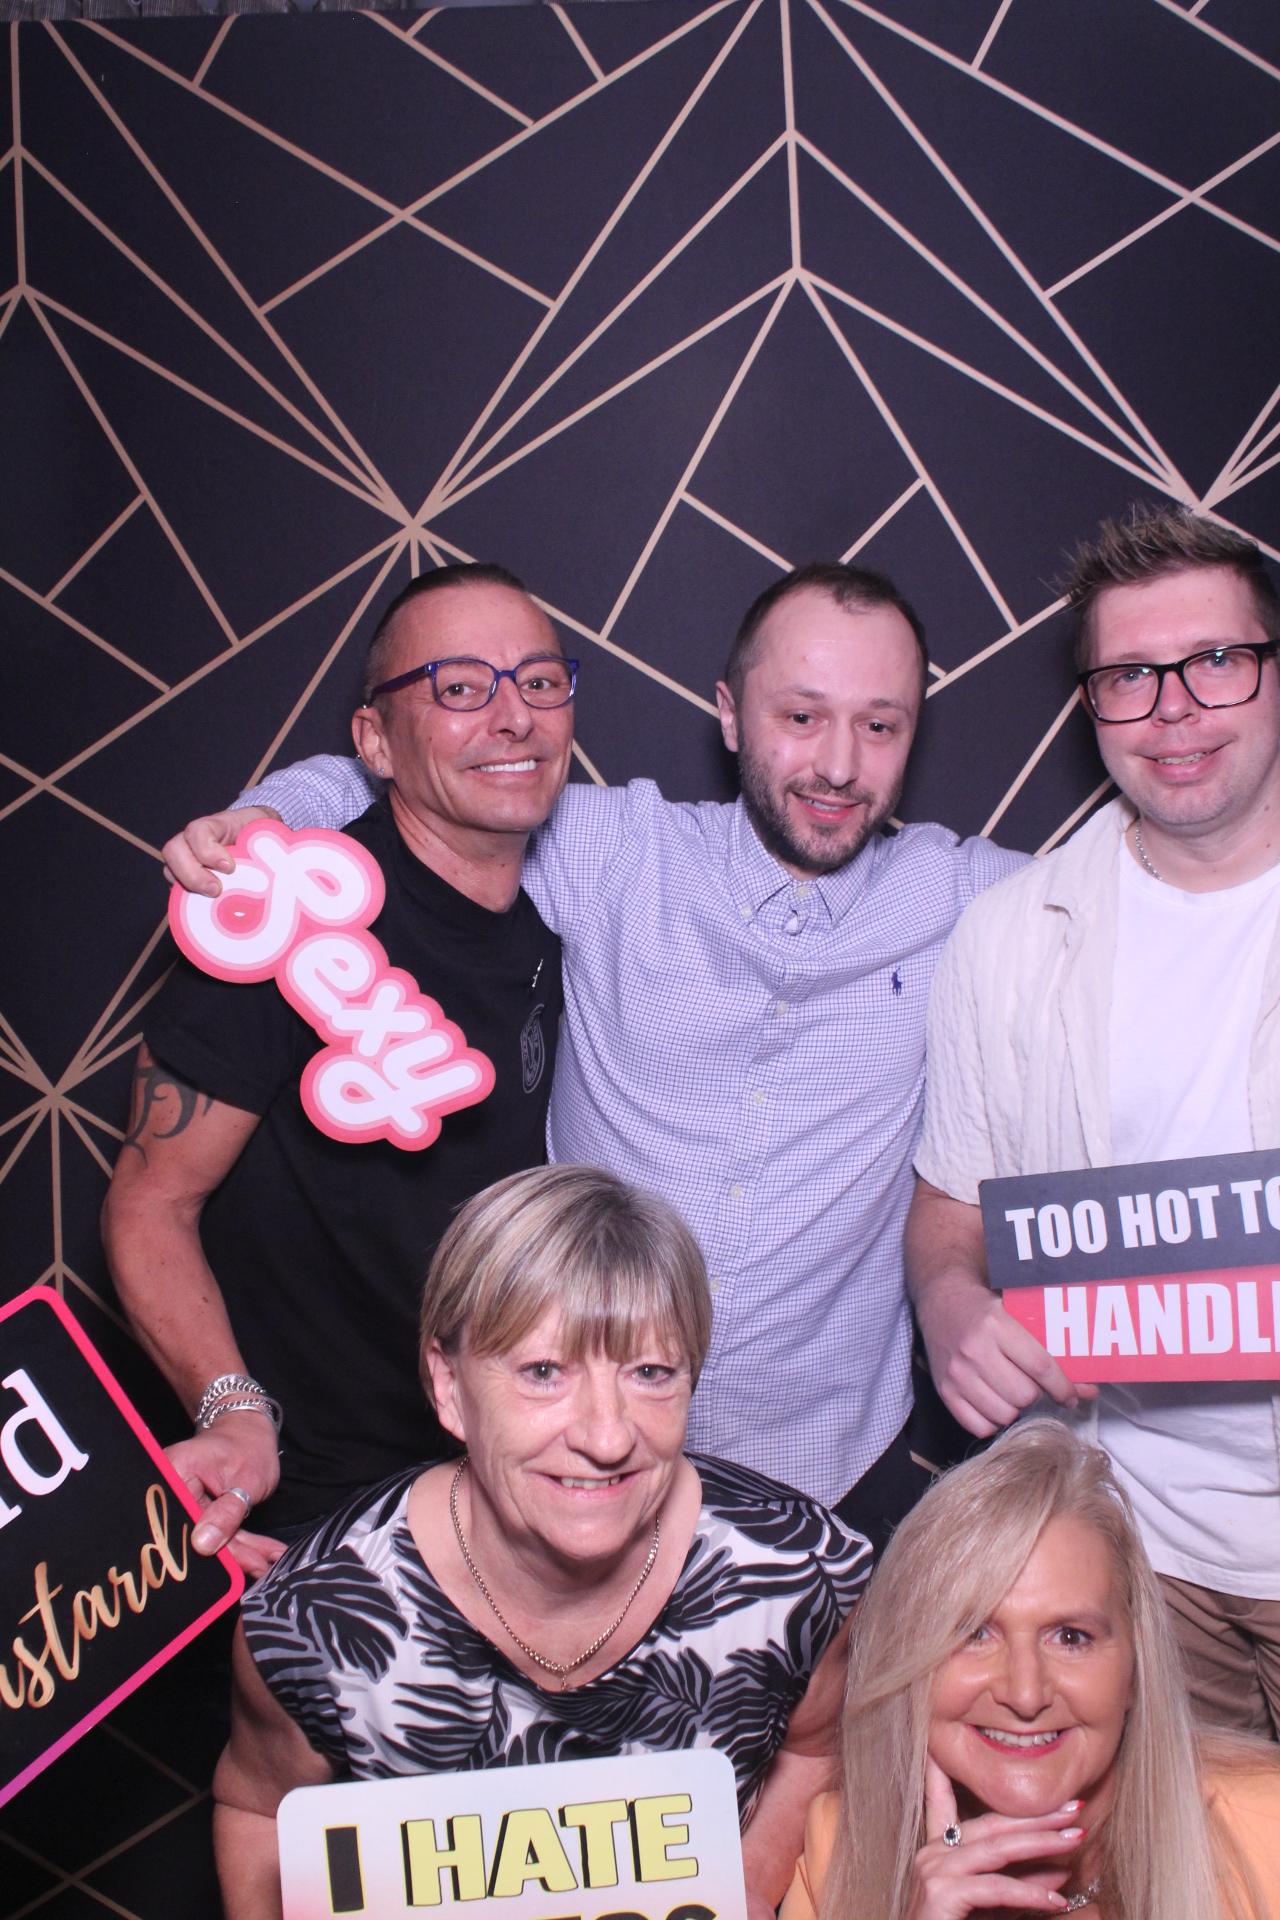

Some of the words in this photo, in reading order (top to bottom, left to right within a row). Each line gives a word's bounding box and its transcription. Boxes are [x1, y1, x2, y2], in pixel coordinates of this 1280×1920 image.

[180, 826, 482, 1136] Sexy
[1005, 1199, 1108, 1260] TOO
[1118, 1185, 1220, 1248] HOT
[1044, 1281, 1280, 1356] HANDL
[325, 1824, 365, 1913] I
[400, 1793, 699, 1906] HATE
